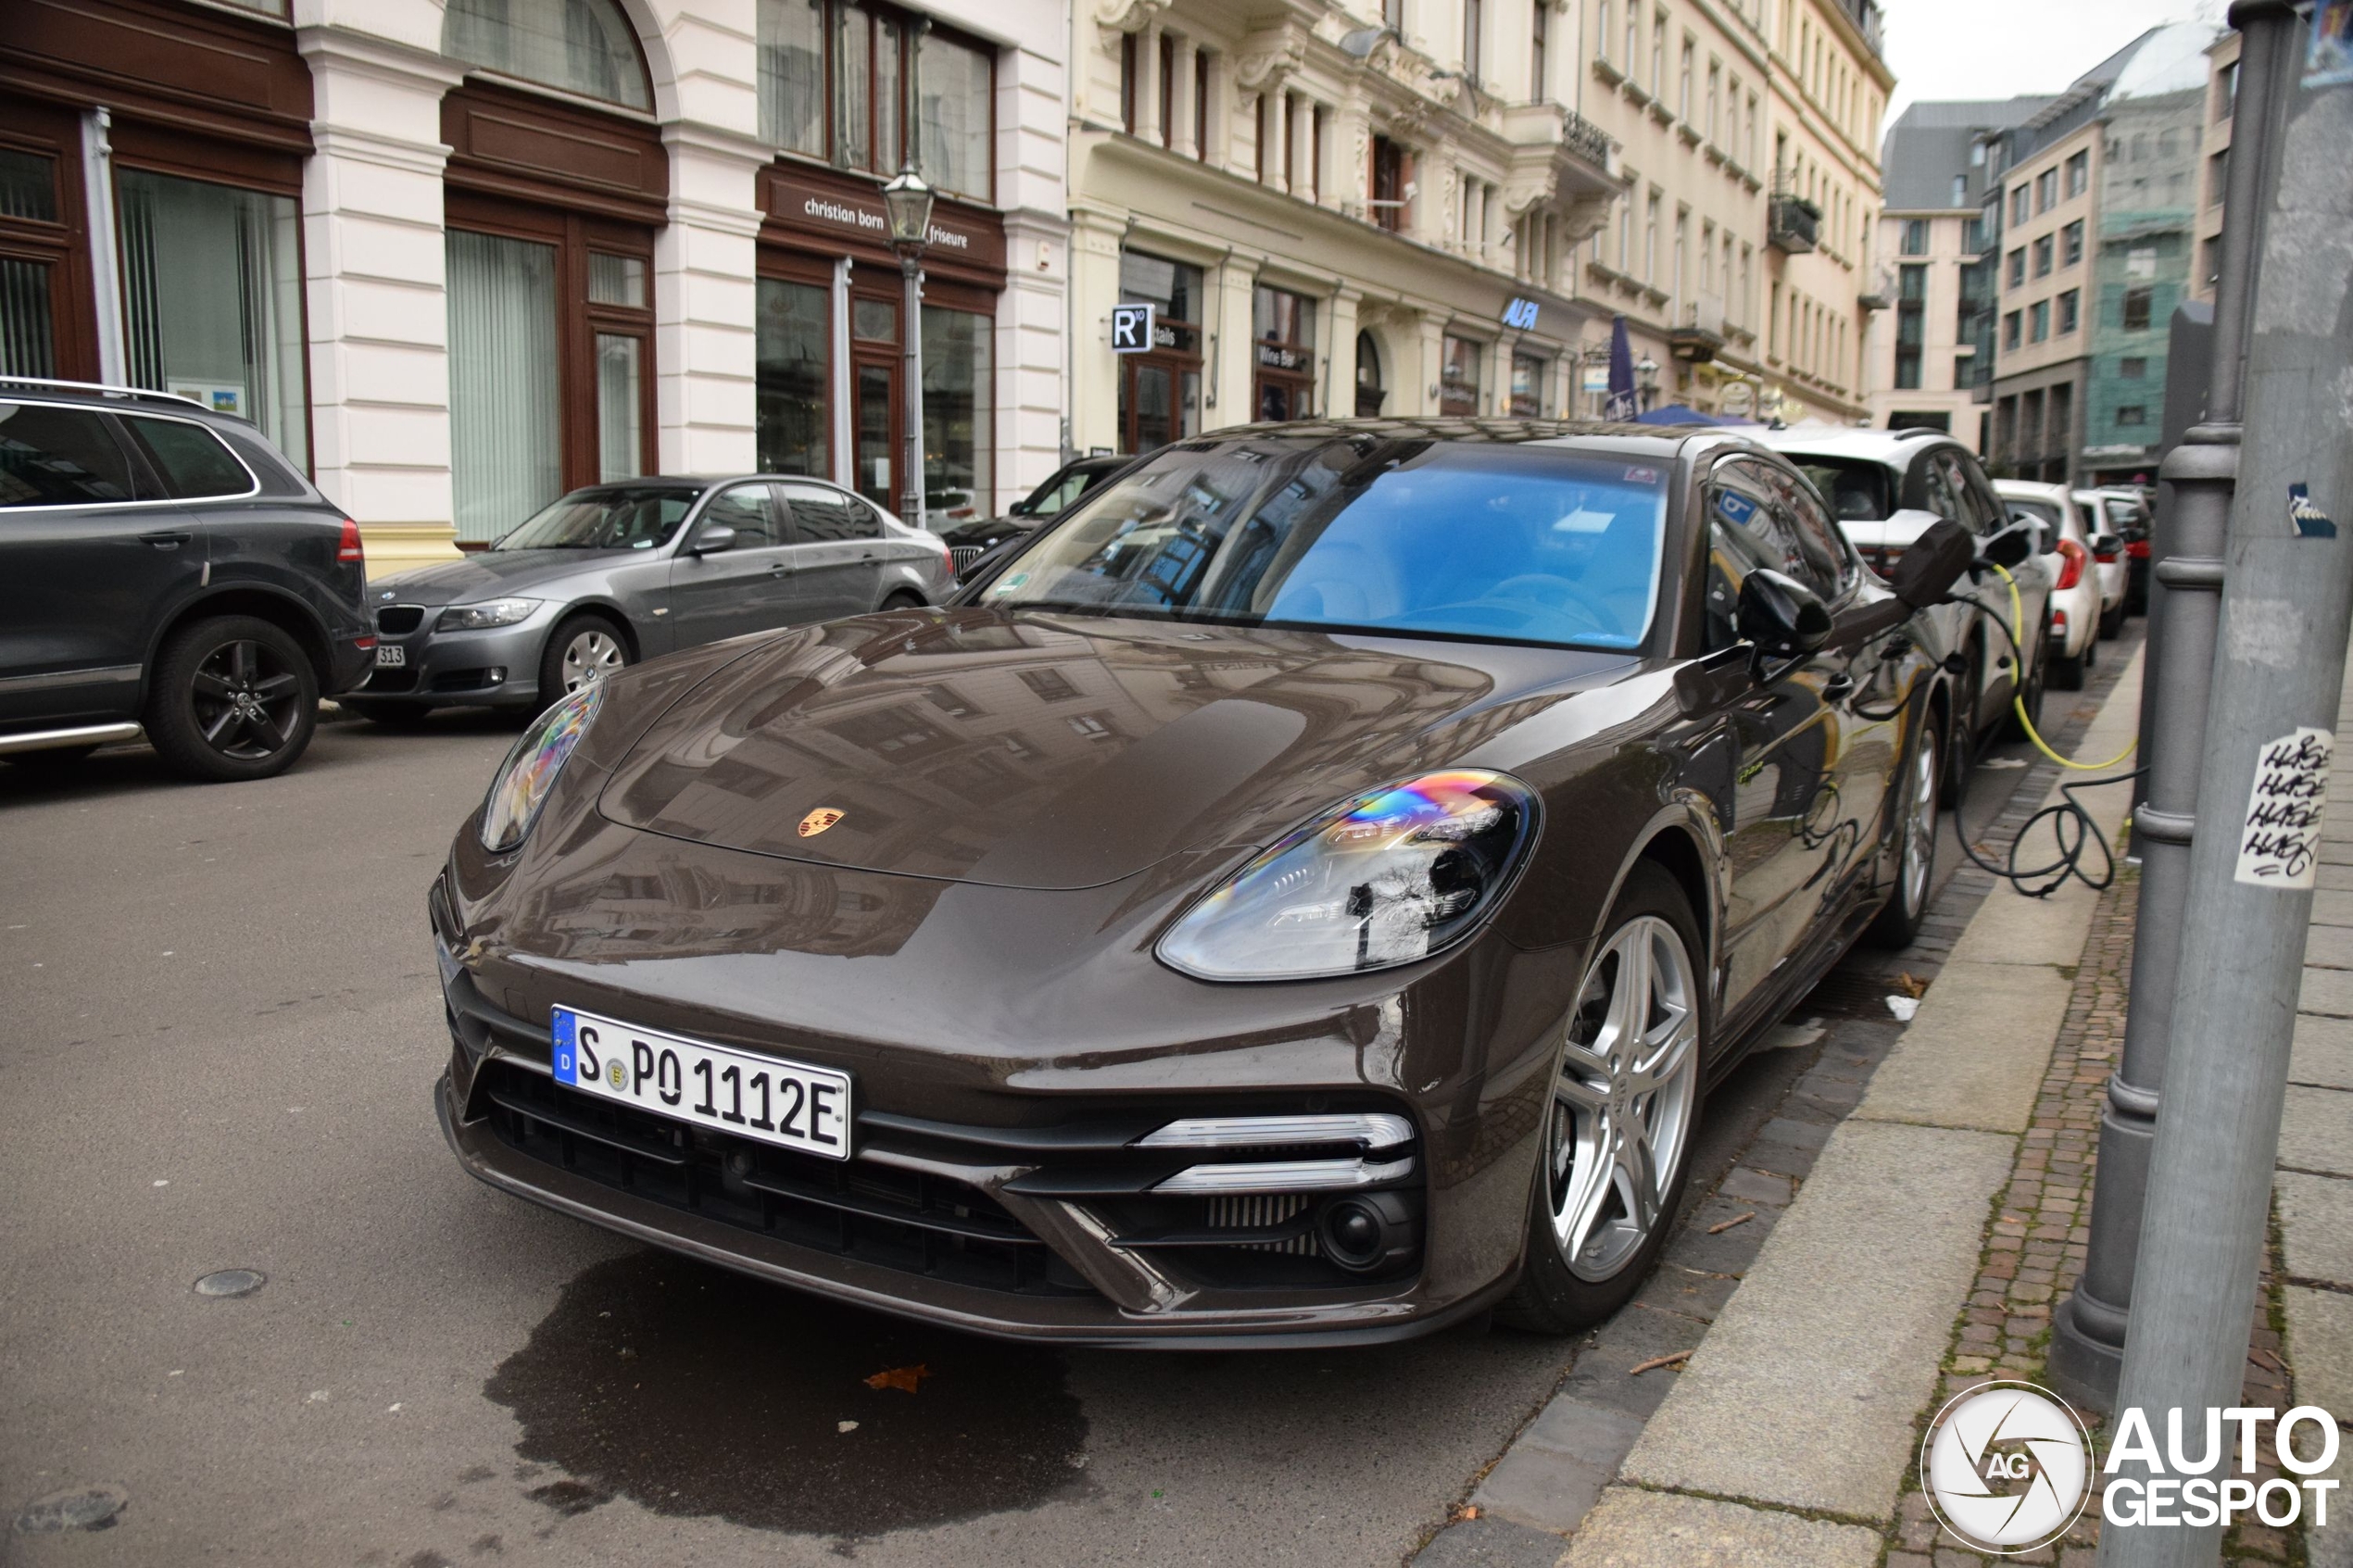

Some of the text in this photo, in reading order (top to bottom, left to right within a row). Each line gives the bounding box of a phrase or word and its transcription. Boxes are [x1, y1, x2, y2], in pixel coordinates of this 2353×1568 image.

[804, 197, 968, 249] christian born friseure
[1502, 297, 1540, 331] ALFA
[1154, 326, 1176, 346] tails
[1260, 345, 1280, 365] Wine
[380, 647, 403, 663] 313
[560, 1053, 571, 1071] D
[579, 1025, 601, 1082] S
